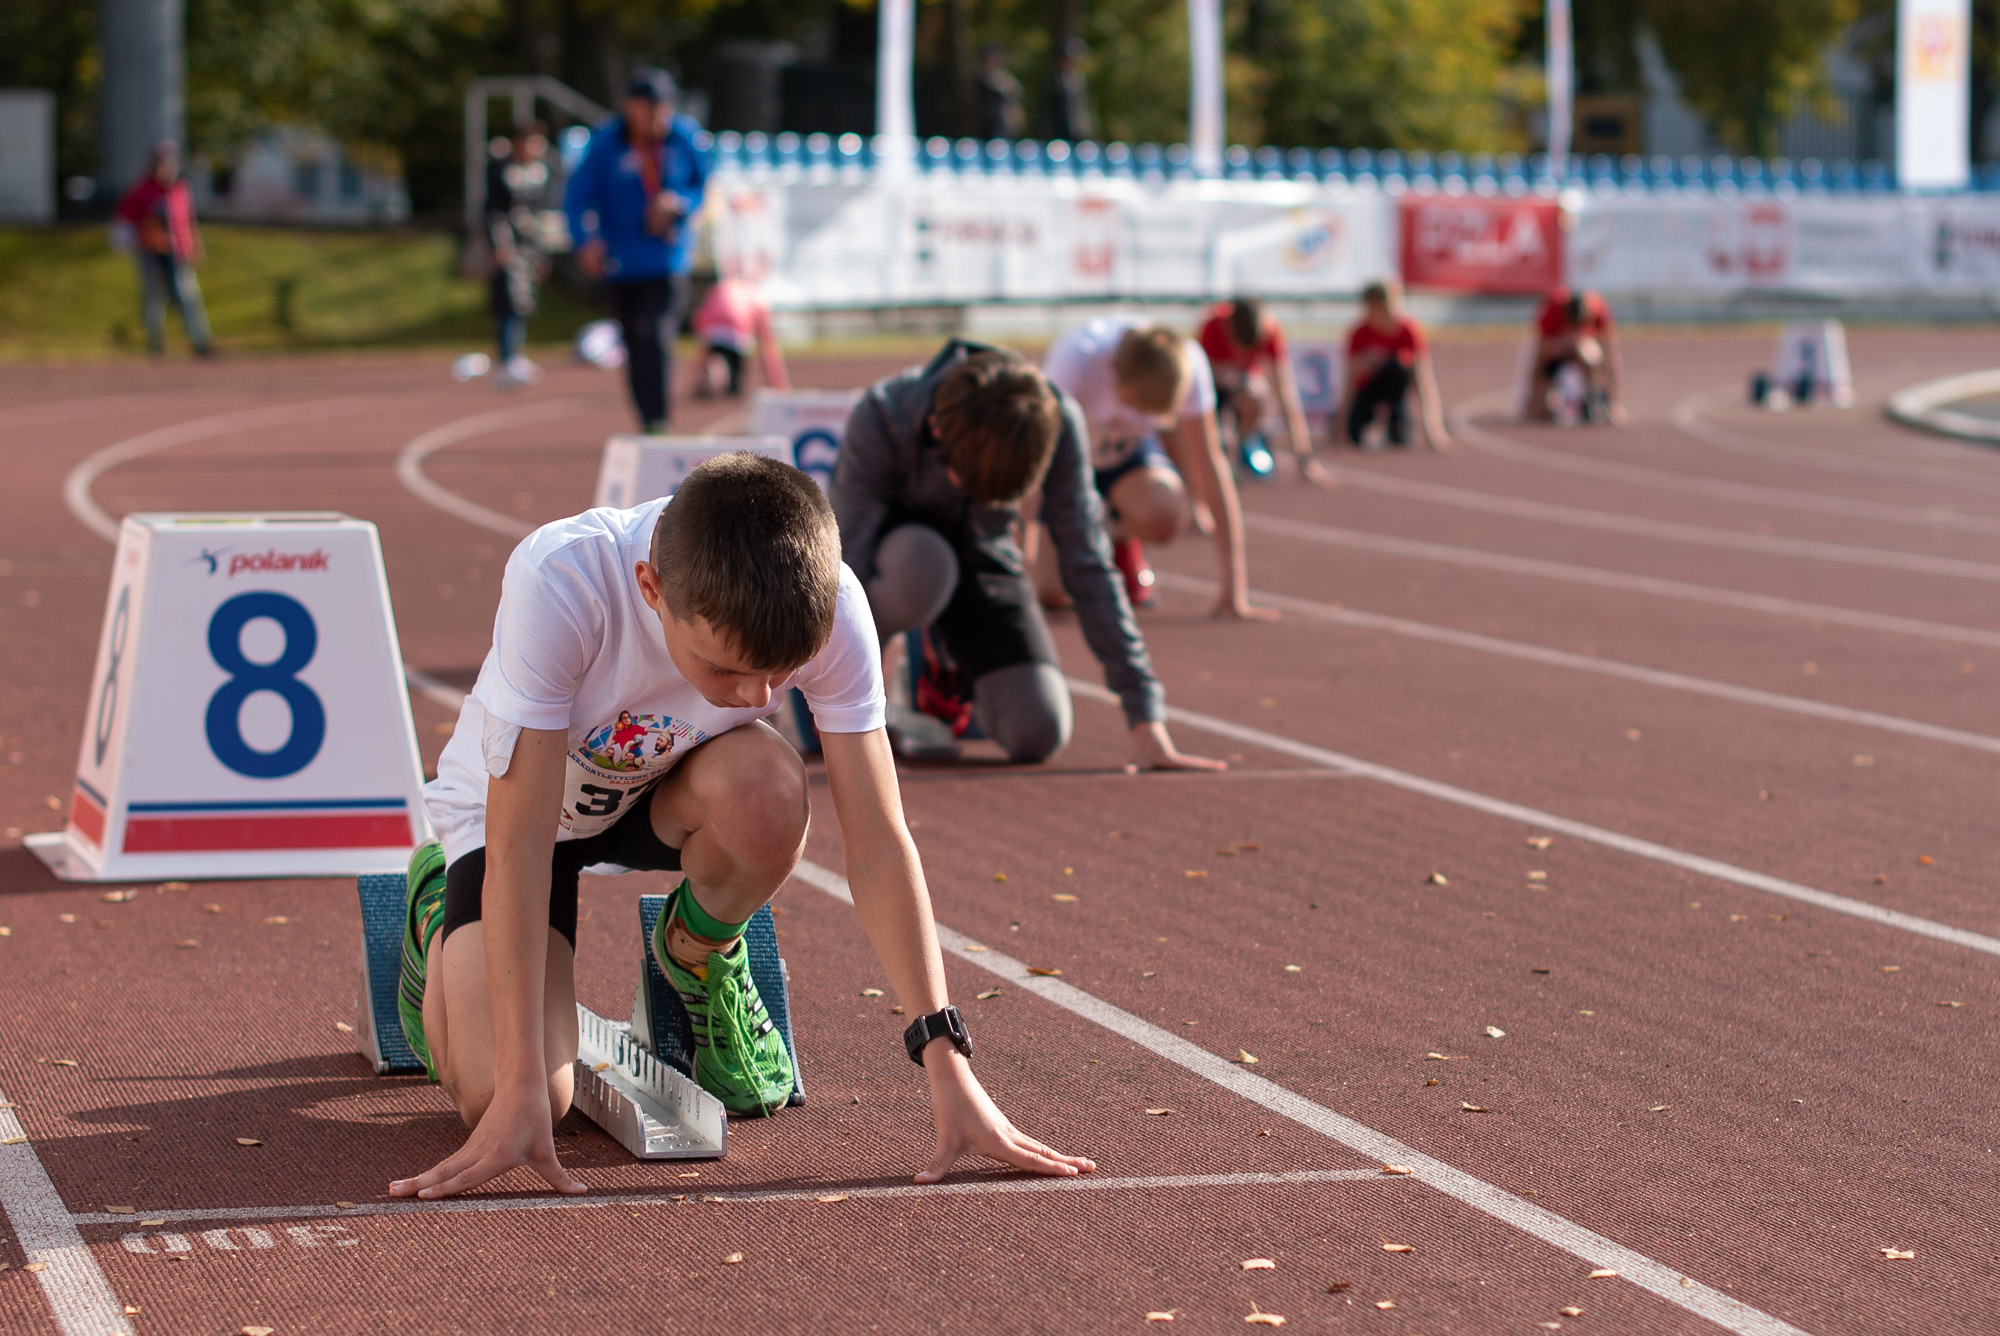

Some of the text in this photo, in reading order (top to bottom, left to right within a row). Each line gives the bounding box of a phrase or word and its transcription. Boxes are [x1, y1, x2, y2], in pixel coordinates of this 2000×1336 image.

[1298, 354, 1332, 406] 3
[229, 548, 329, 579] polanik
[205, 590, 327, 780] 8
